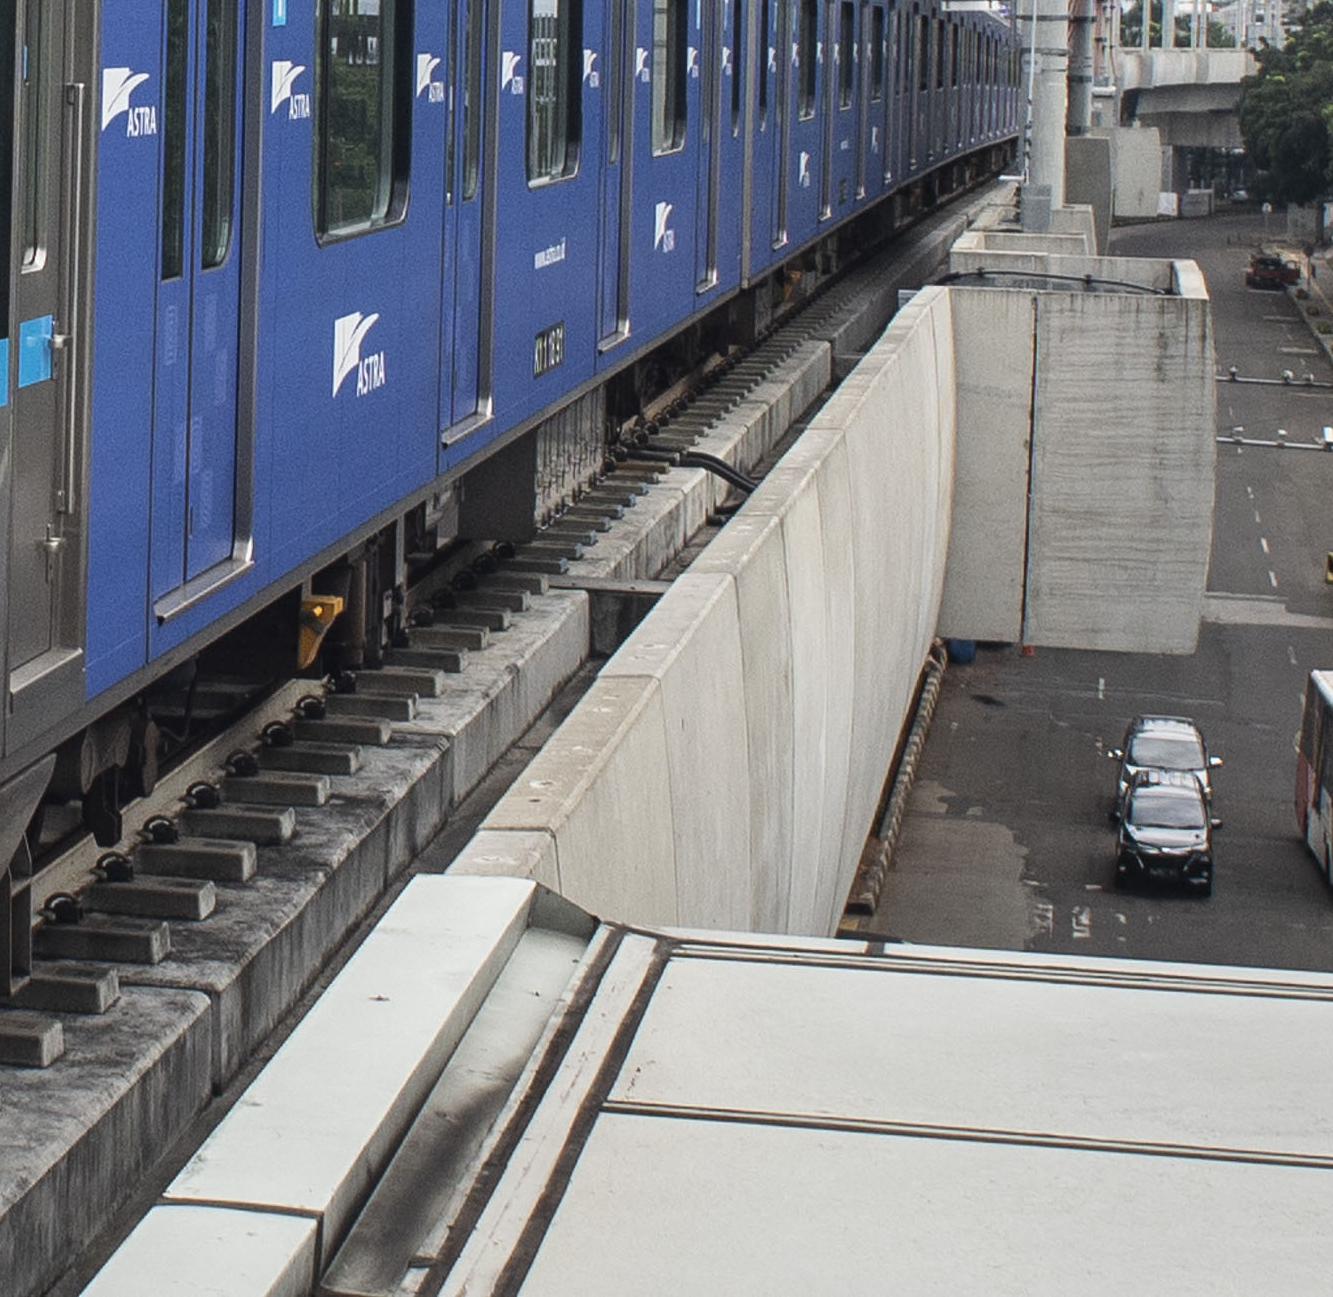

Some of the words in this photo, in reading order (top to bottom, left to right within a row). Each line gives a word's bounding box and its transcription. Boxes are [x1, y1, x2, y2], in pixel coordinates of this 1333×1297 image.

[127, 106, 157, 138] ASTRA
[289, 94, 310, 120] ASTRA
[357, 350, 385, 398] ASTRA
